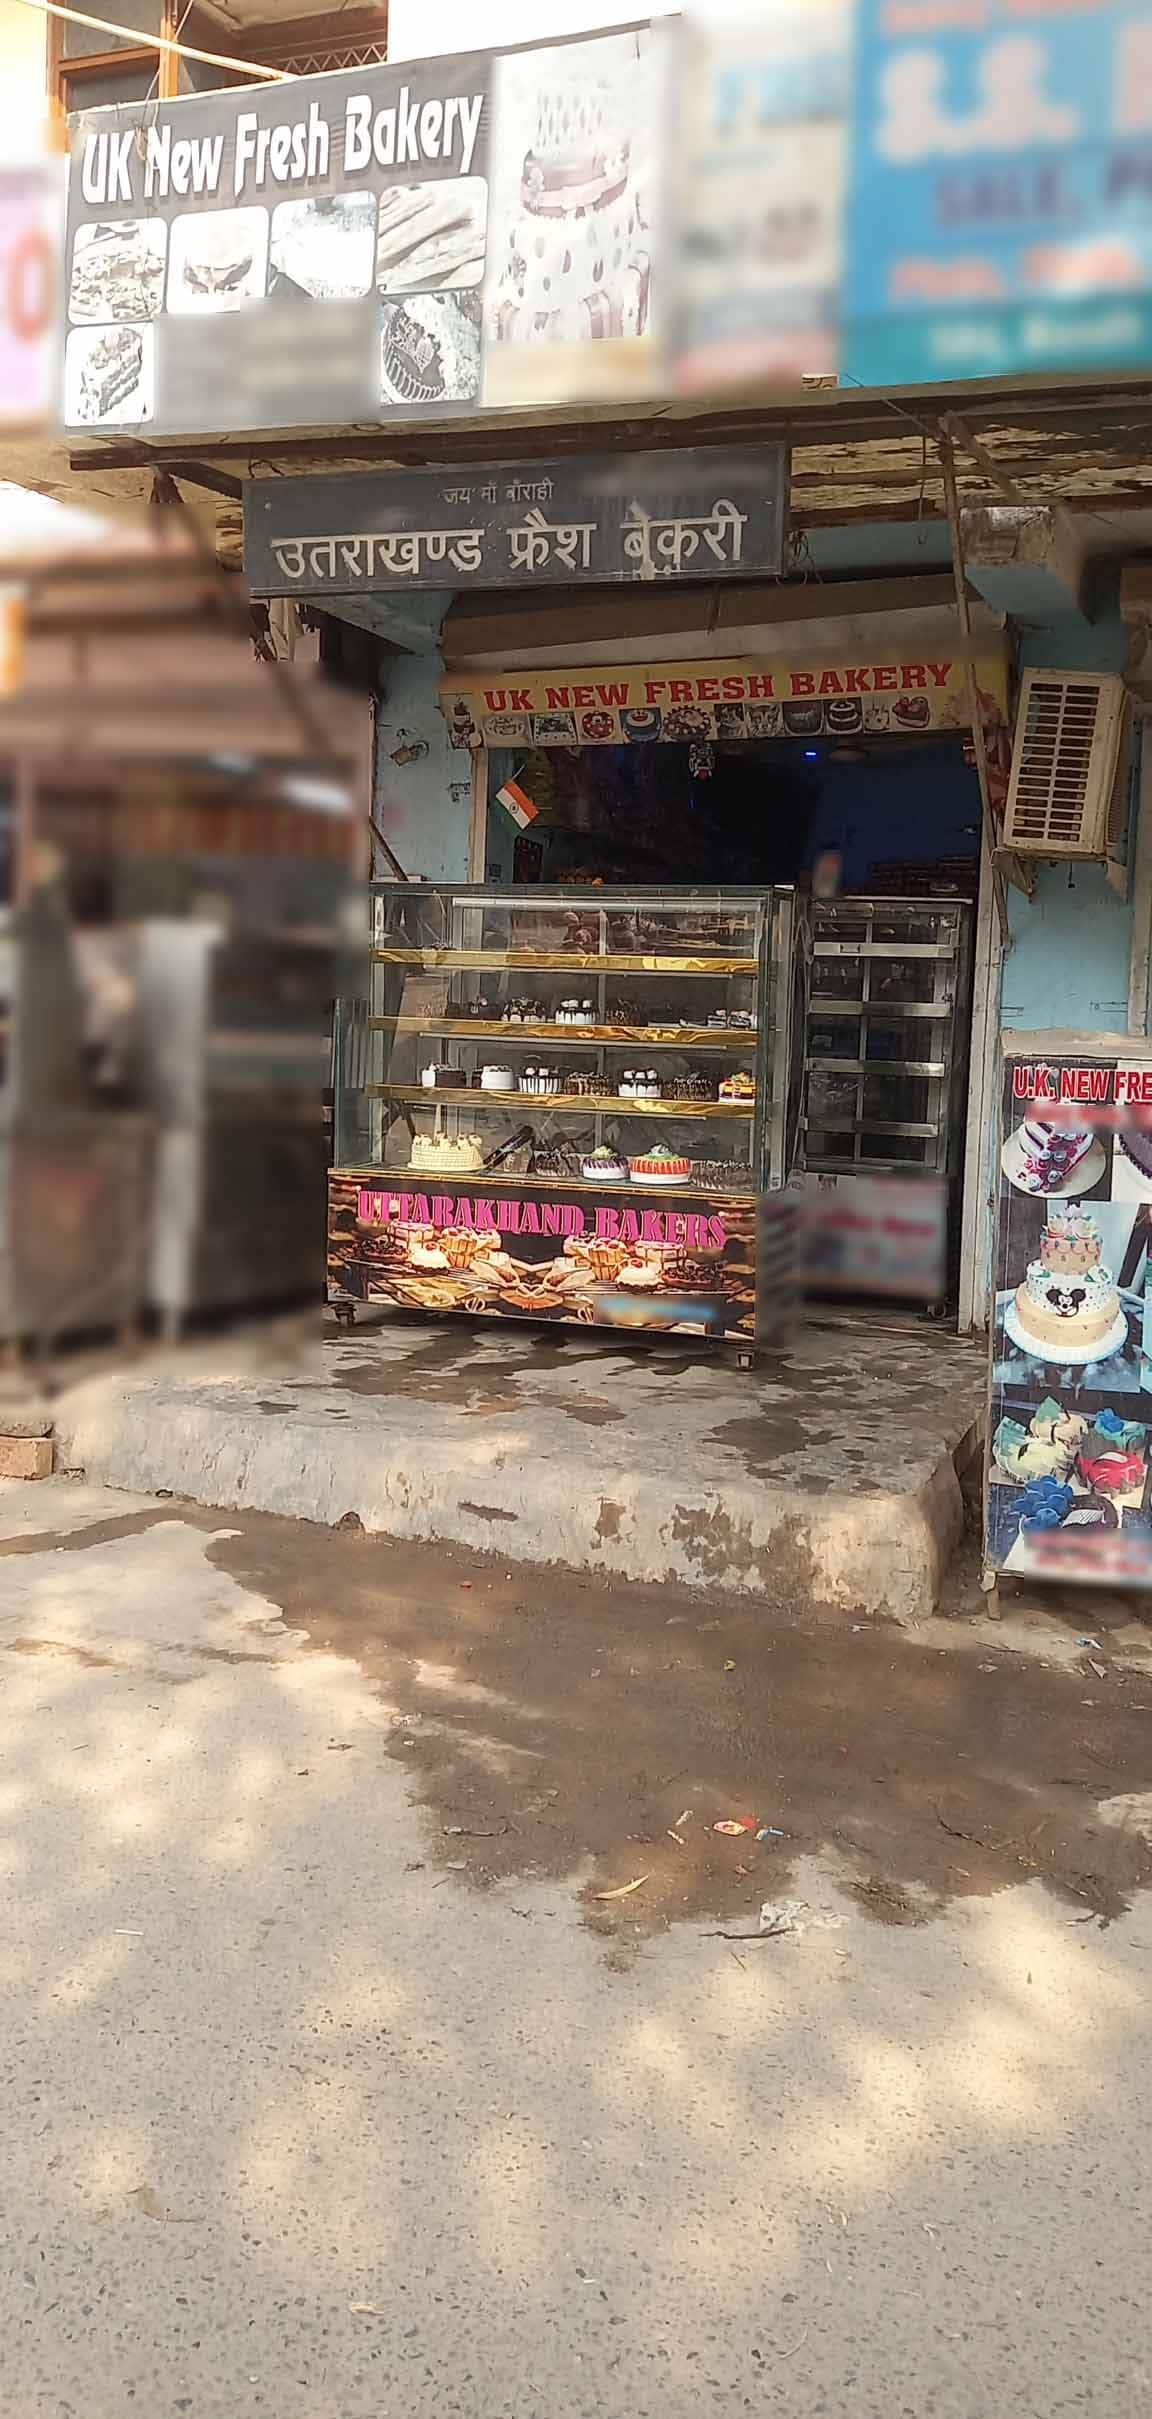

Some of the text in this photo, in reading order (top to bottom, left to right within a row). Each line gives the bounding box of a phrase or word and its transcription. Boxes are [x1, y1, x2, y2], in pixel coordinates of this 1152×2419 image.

[82, 86, 484, 204] UK New Fresh Bakery
[443, 487, 472, 505] जय
[270, 529, 485, 578] उतराखण्ड
[506, 507, 597, 571] फ्रैश
[484, 664, 952, 712] UK NEW FRESH BAKERY
[1013, 1066, 1056, 1100] U.K.
[1060, 1067, 1110, 1101] NEW
[357, 1190, 727, 1249] UTTARAKHAND BAKERS
